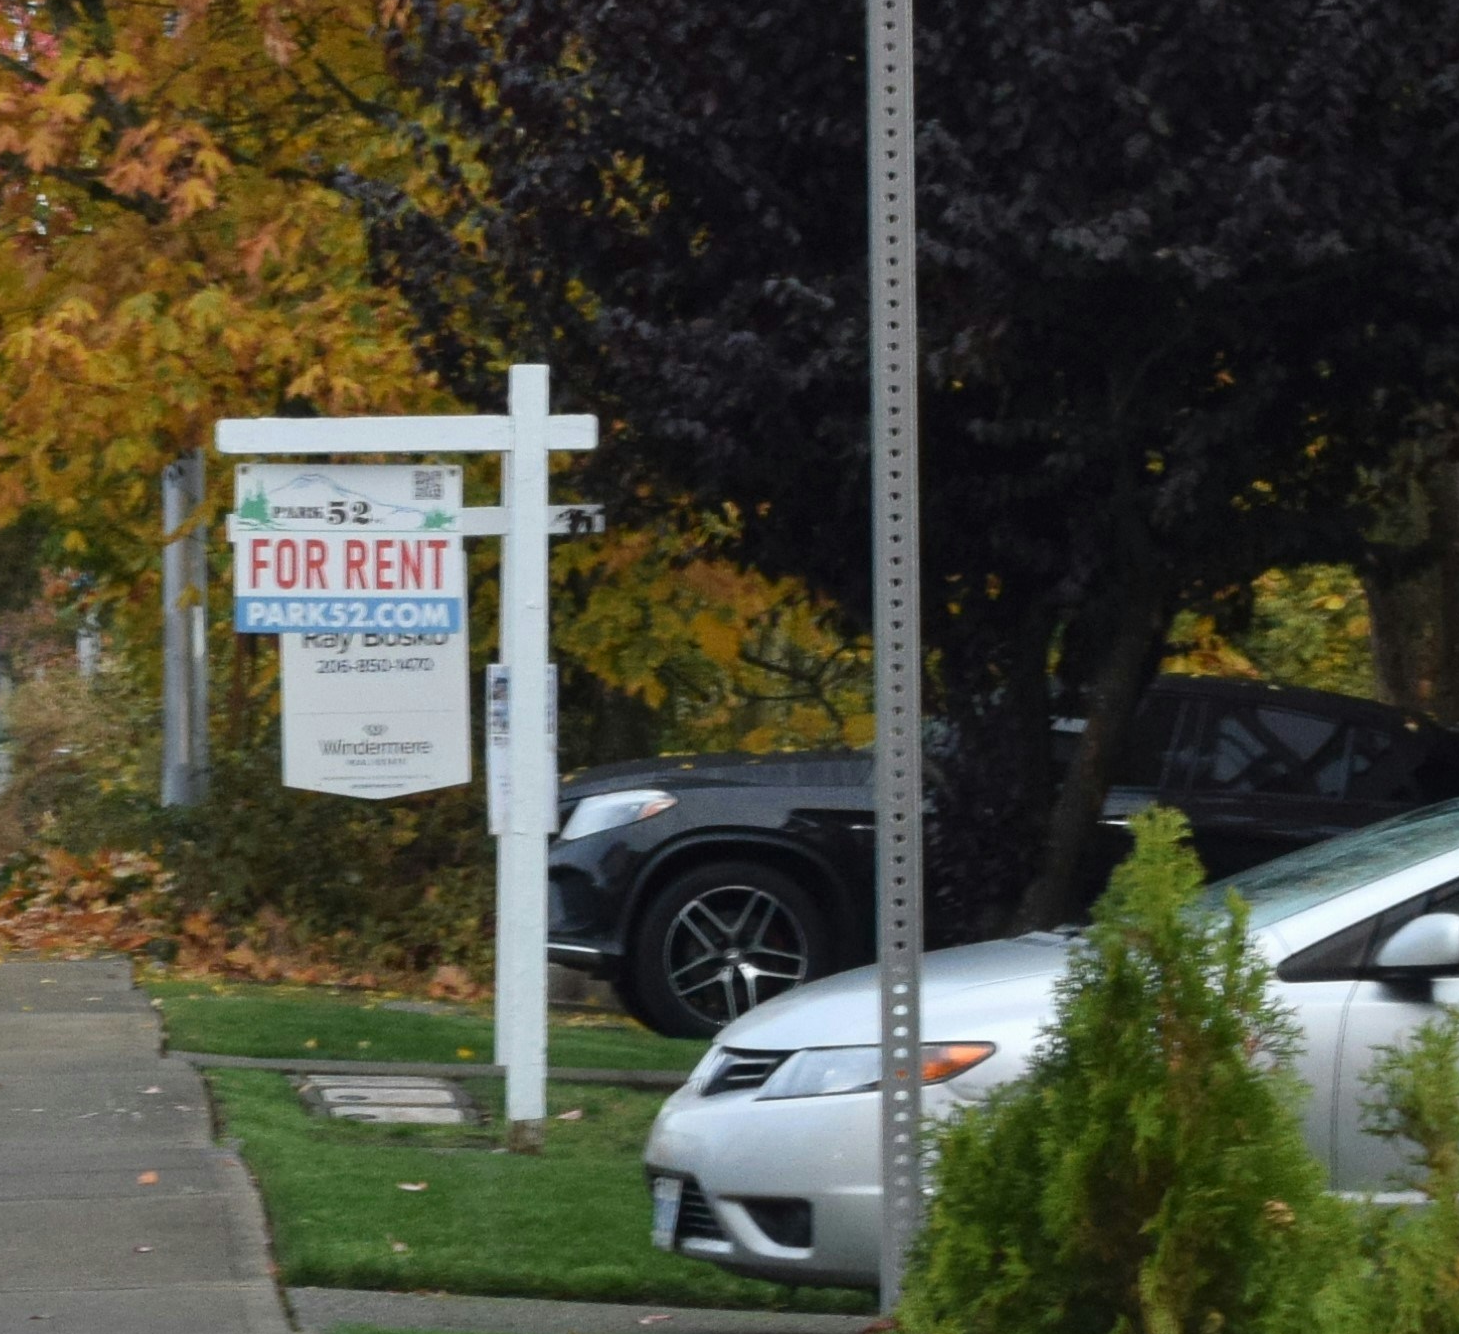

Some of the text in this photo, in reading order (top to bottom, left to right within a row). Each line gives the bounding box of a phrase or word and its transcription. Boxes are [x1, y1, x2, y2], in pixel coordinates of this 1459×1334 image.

[327, 501, 372, 525] 52
[248, 538, 450, 590] FOR RENT
[245, 601, 451, 627] PARK52.COM
